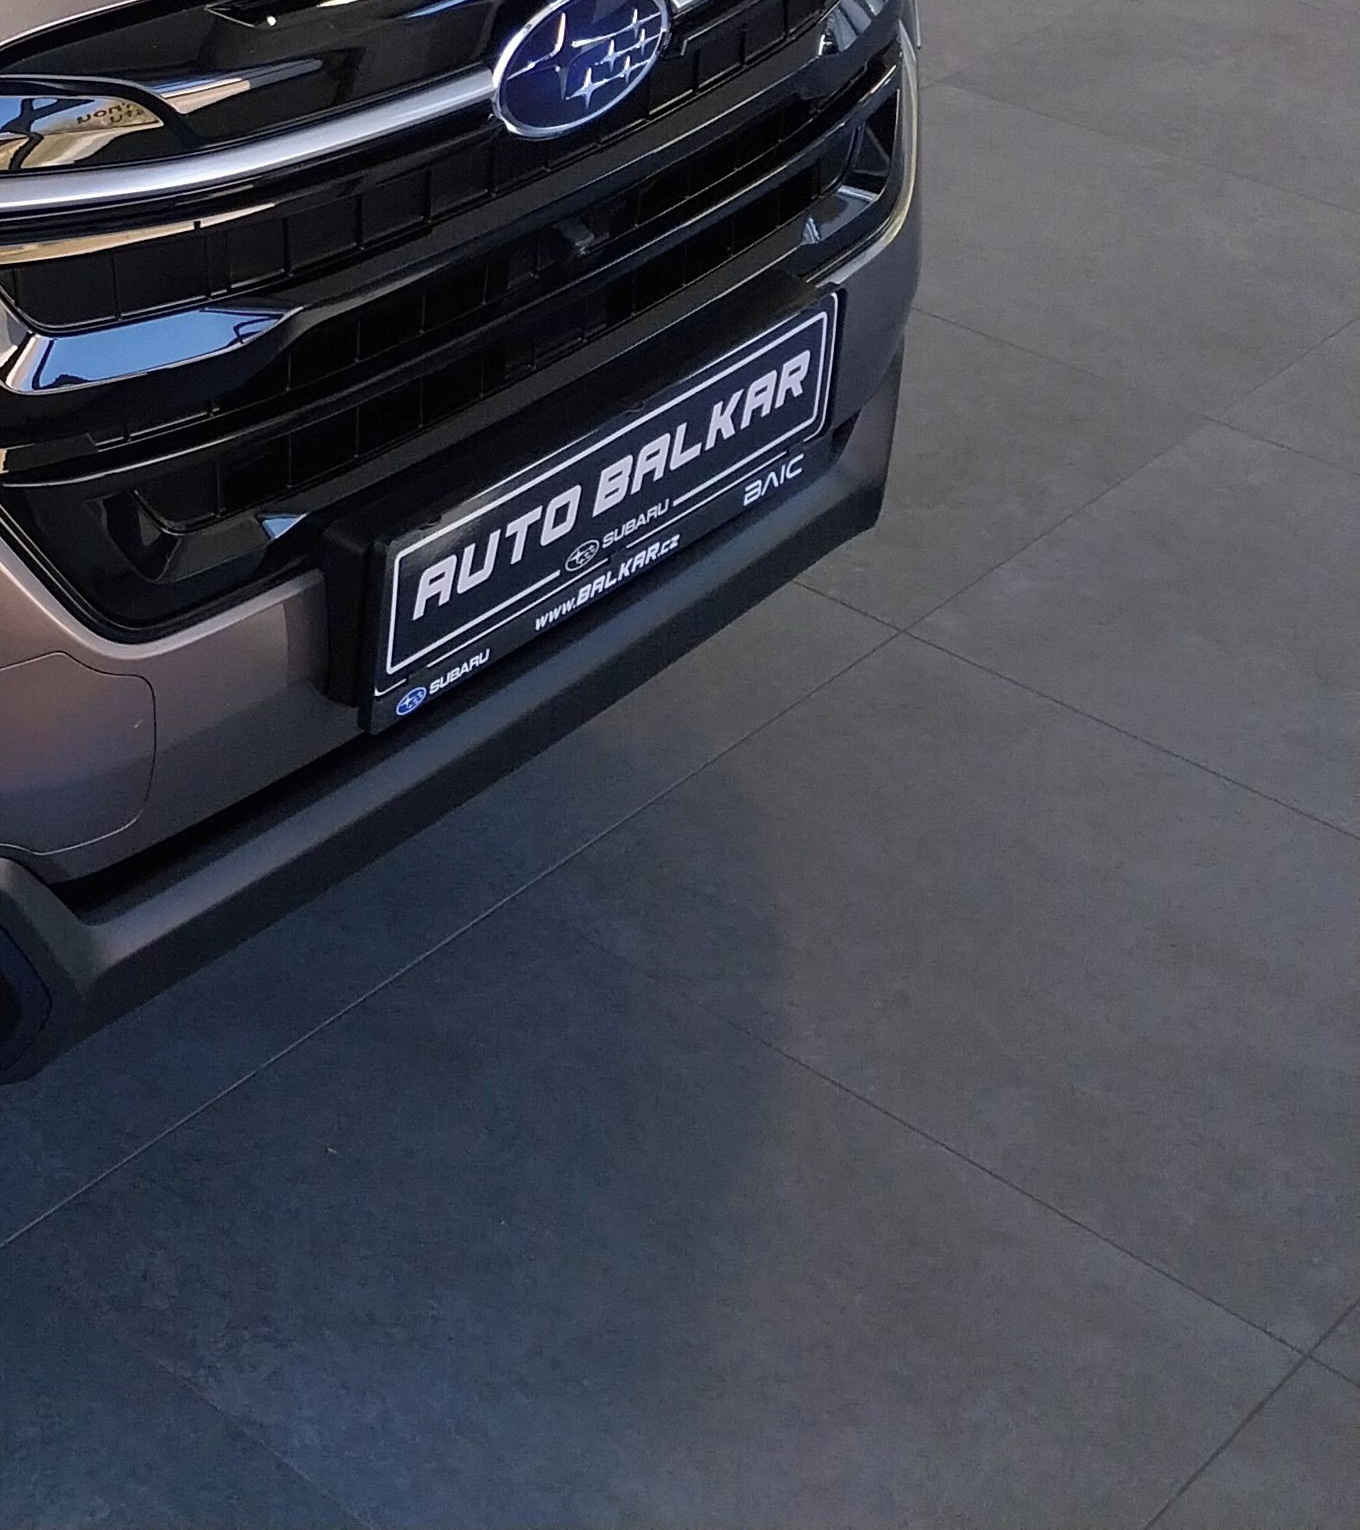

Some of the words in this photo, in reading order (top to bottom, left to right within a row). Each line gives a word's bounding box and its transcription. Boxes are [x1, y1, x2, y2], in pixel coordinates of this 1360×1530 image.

[412, 484, 582, 621] AUTO
[592, 349, 811, 518] BALKAR
[743, 453, 805, 507] BAIC
[602, 498, 670, 549] SUBARU
[535, 533, 681, 631] www.BALKAR.cz
[429, 648, 491, 696] SUBARU
